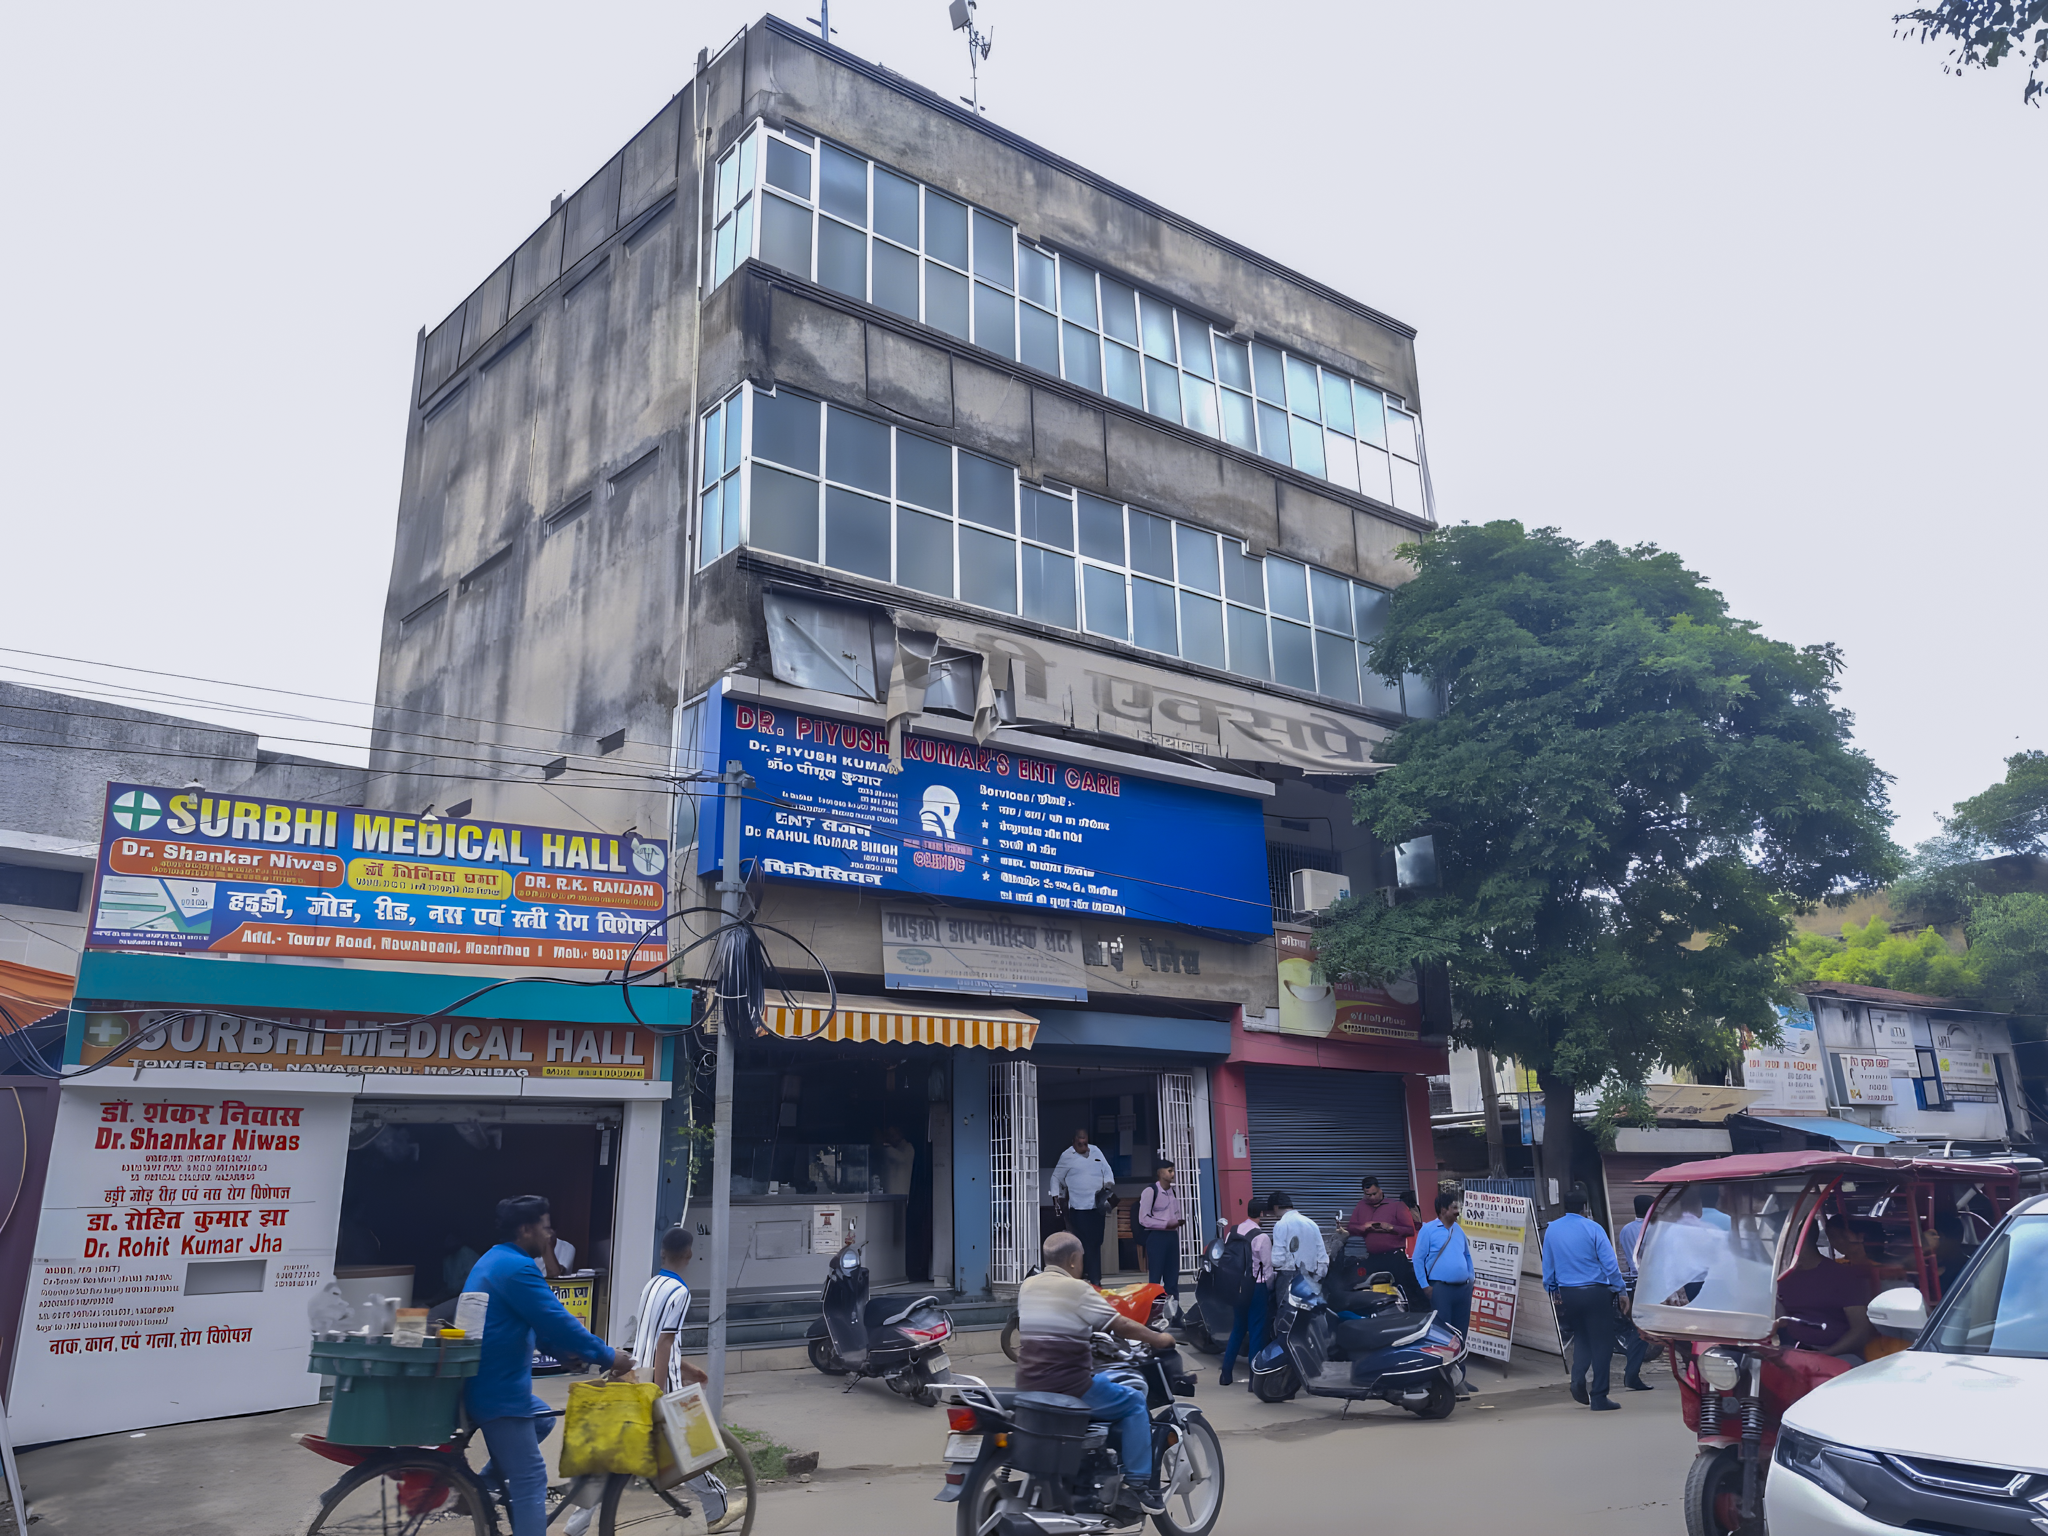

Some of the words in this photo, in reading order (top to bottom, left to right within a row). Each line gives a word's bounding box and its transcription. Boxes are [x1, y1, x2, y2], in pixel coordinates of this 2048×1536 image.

[736, 704, 784, 737] DR.
[796, 716, 890, 755] PIYUSH
[903, 736, 1010, 776] KUMAR'S
[1018, 758, 1057, 785] ENT
[1065, 768, 1121, 797] CARE
[749, 739, 770, 753] Dr.
[166, 794, 338, 848] SURBHI
[352, 813, 530, 866] MEDICAL
[542, 832, 628, 873] HALL
[765, 828, 811, 844] RAHUL
[121, 840, 155, 858] Dr.
[163, 844, 263, 868] Shankar
[269, 853, 338, 872] Niwas
[524, 874, 551, 889] DR.
[556, 877, 588, 892] R.K.
[471, 903, 506, 928] एवं
[554, 908, 590, 932] रोग
[135, 1012, 327, 1056] SURBHI
[340, 1020, 535, 1062] MEDICAL
[546, 1028, 646, 1066] HALL
[143, 1099, 214, 1125] शंकर
[219, 1100, 305, 1127] निवास
[130, 1127, 227, 1151] Shankar
[232, 1128, 301, 1151] Niwas
[124, 1207, 185, 1231] रोहित
[193, 1209, 252, 1233] कुमार
[258, 1208, 290, 1228] झा
[83, 1237, 110, 1258] Dr.
[117, 1236, 170, 1258] Rohit
[180, 1234, 244, 1256] Kumar
[249, 1232, 283, 1254] Jha
[179, 1327, 203, 1347] रोग
